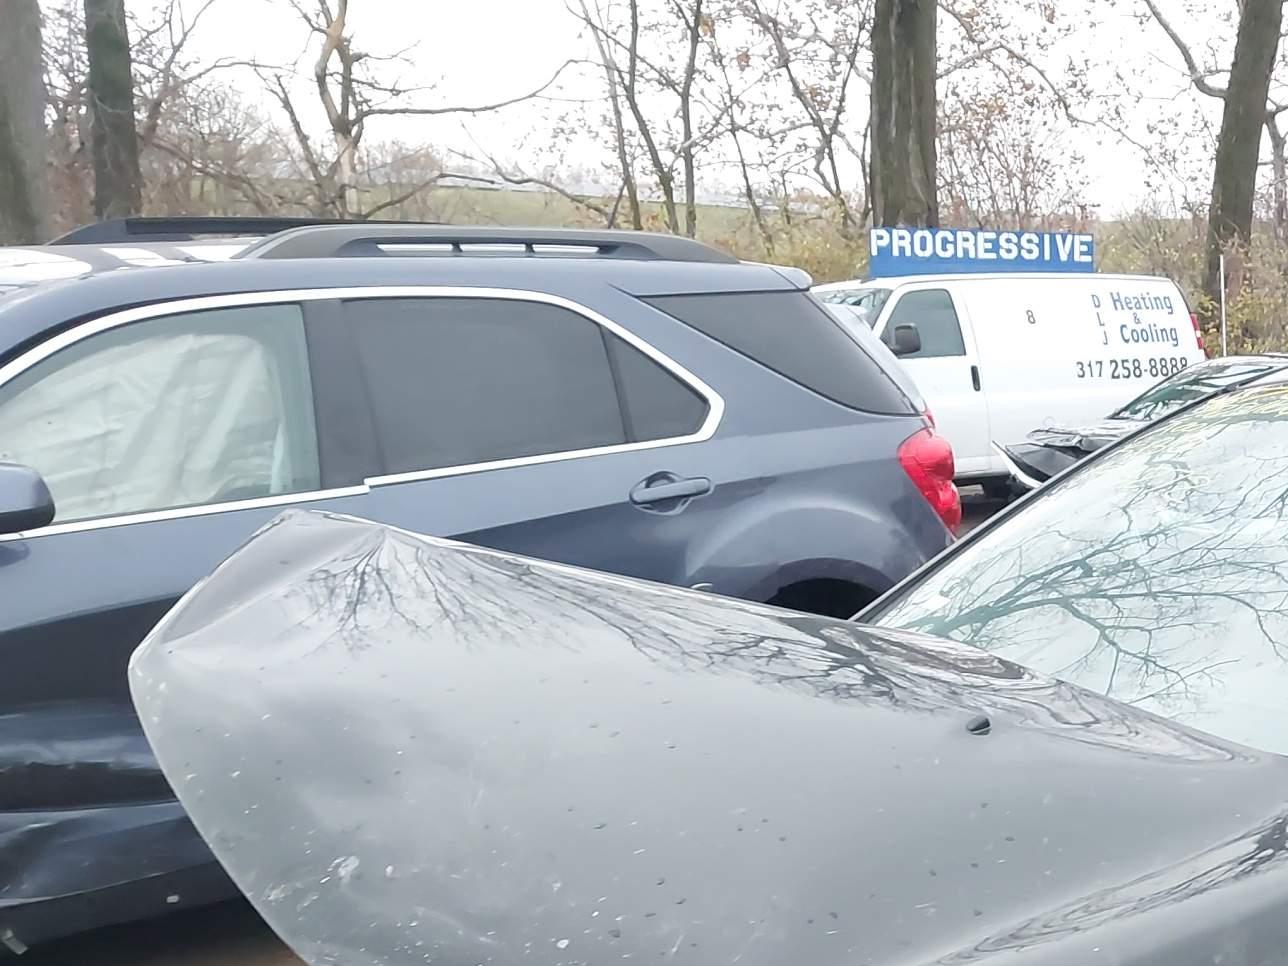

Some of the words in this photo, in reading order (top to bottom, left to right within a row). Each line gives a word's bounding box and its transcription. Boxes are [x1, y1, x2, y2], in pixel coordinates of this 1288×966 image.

[869, 228, 1093, 262] PROGRESSIVE
[1110, 291, 1174, 315] Heating
[1132, 312, 1142, 325] &
[1119, 323, 1179, 347] Cooling
[1076, 360, 1104, 379] 317
